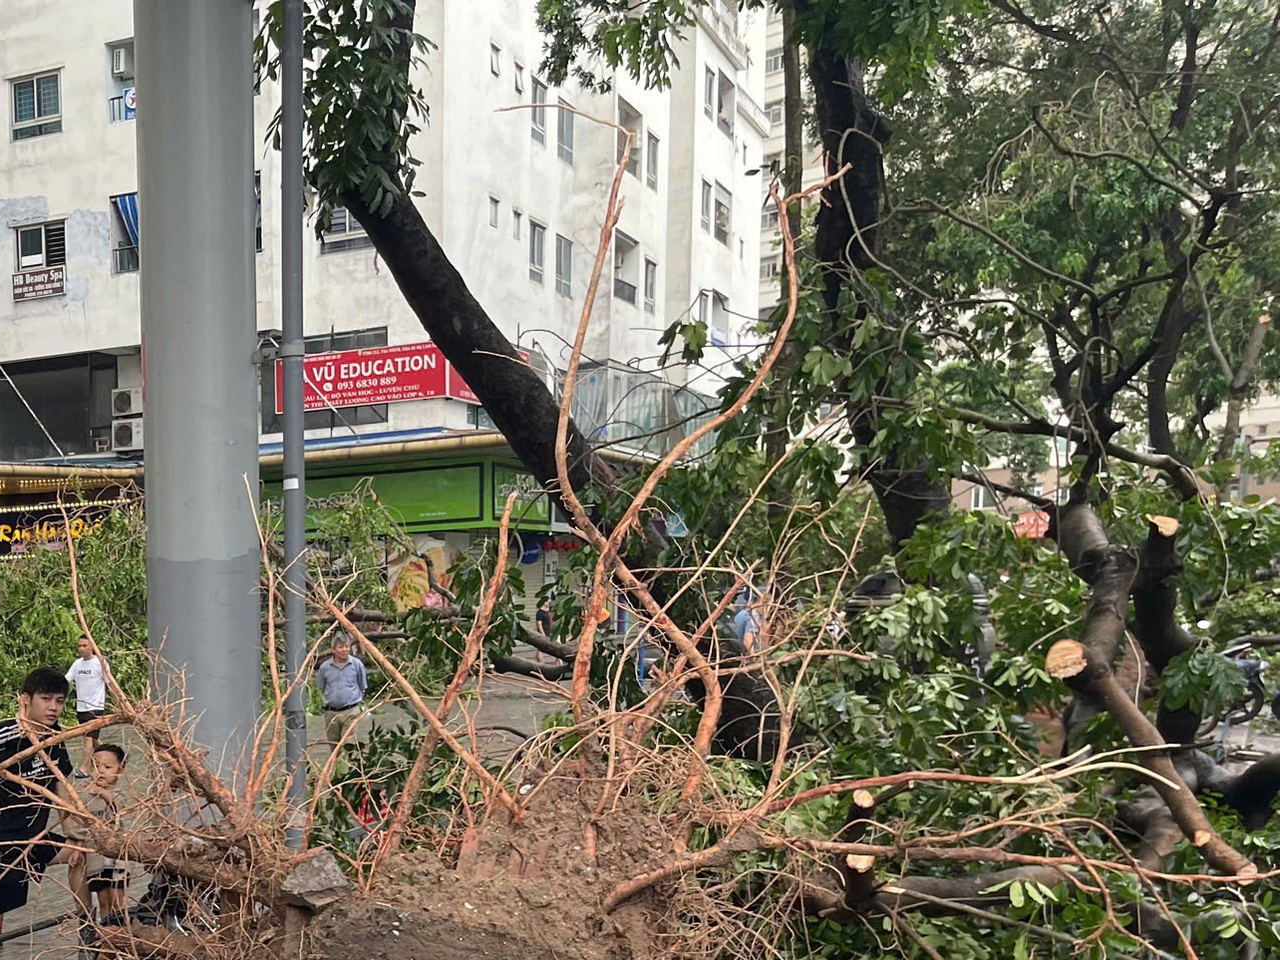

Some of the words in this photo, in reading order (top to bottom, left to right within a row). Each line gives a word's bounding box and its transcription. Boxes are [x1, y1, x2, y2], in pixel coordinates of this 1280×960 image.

[25, 273, 48, 283] Beauty
[49, 270, 62, 281] Spa
[312, 361, 335, 382] VŨ
[340, 353, 436, 379] EDUCATION
[337, 381, 354, 391] 093
[356, 378, 378, 389] 6830
[380, 376, 397, 386] 889
